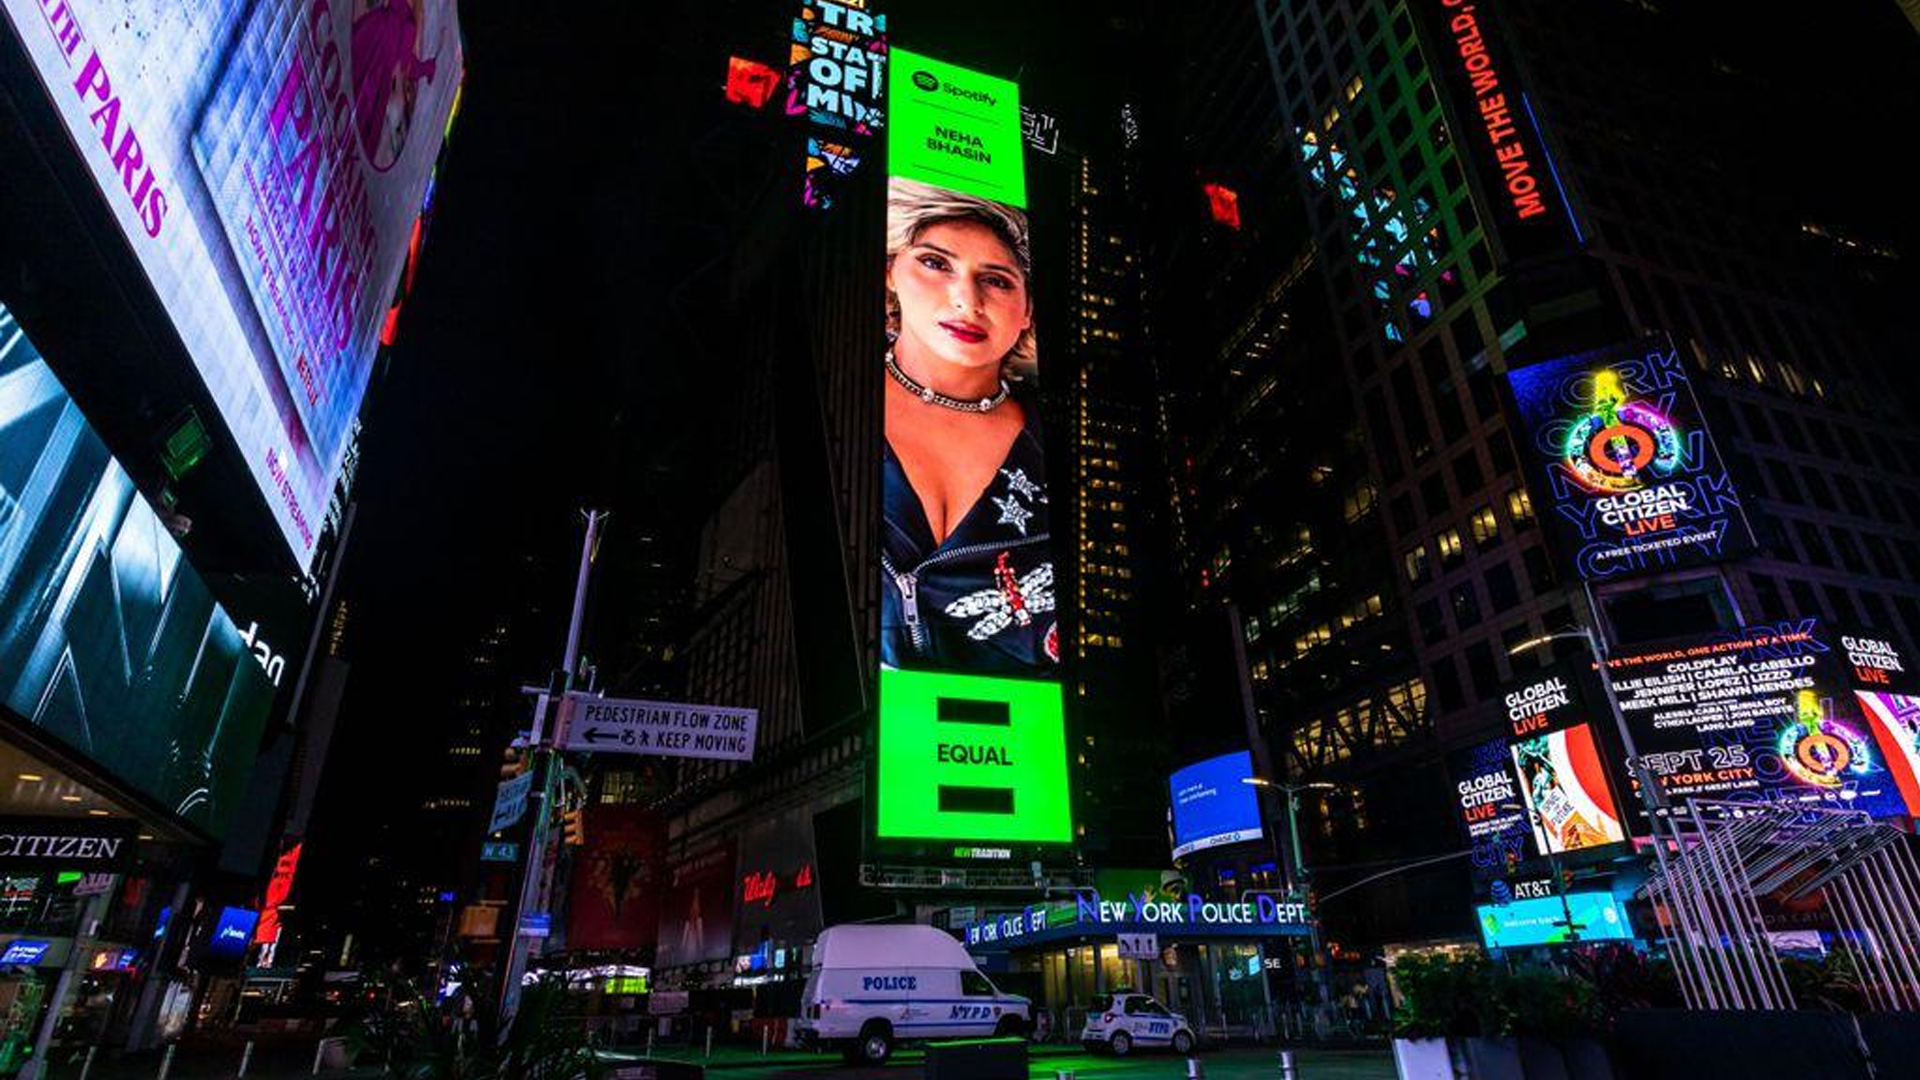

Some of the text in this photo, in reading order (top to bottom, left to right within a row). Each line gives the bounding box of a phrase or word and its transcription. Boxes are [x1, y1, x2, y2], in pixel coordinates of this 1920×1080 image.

[809, 57, 868, 93] OF
[942, 81, 998, 108] Spotify
[1451, 5, 1546, 220] MOVE THE WORLD,
[72, 49, 169, 239] PARIS
[935, 126, 984, 149] NEHA
[926, 138, 992, 165] BHASIN
[269, 49, 357, 350] PARIS
[246, 215, 296, 344] NOW STREAMING
[265, 447, 313, 551] NOW STREAMING
[1596, 484, 1687, 512] GLOBAL
[1624, 514, 1676, 536] LIVE
[1605, 547, 1630, 558] FREE
[1631, 538, 1681, 554] TICKETED
[1682, 530, 1718, 545] EVENT
[1623, 655, 1643, 667] THE
[1687, 646, 1711, 656] ONE
[1712, 640, 1754, 653] ACTION
[1755, 638, 1769, 647] AT
[1842, 636, 1899, 657] GLOBAL
[1643, 672, 1687, 688] EILISH
[1694, 666, 1749, 680] CAMILA
[1748, 655, 1816, 674] CABELLO
[1666, 655, 1738, 673] COLDPLAY
[1855, 667, 1890, 684] LIVE
[1505, 676, 1567, 708] GLOBAL
[1618, 697, 1657, 711] MEEK
[1658, 693, 1691, 706] MILL
[1697, 687, 1752, 701] SHAWN
[1752, 676, 1815, 695] MENDES
[1632, 669, 1792, 699] JENNIFER LOPEZ LIZZO
[1764, 697, 1787, 708] BOY
[584, 705, 748, 732] PEDESTRIAN FLOW ZONE
[1513, 712, 1549, 735] LIVE
[1685, 713, 1725, 725] LAUPER
[1696, 722, 1725, 733] LANG
[656, 731, 747, 753] KEEP MOVING
[937, 744, 1014, 766] EQUAL
[1708, 745, 1750, 769] 25
[1458, 769, 1513, 795] GLOBAL
[1671, 772, 1714, 786] YORK
[1718, 768, 1755, 782] CITY
[1465, 802, 1497, 822] LIVE
[0, 834, 122, 859] CITIZEN
[1514, 879, 1552, 899] AT&T
[1023, 905, 1047, 934] DEPT
[1076, 891, 1306, 924] NEW YORK POLICE DEPT
[1263, 958, 1282, 969] SE
[863, 976, 917, 991] POLICE
[949, 1005, 992, 1020] NYPD
[1149, 1021, 1170, 1034] NYPD
